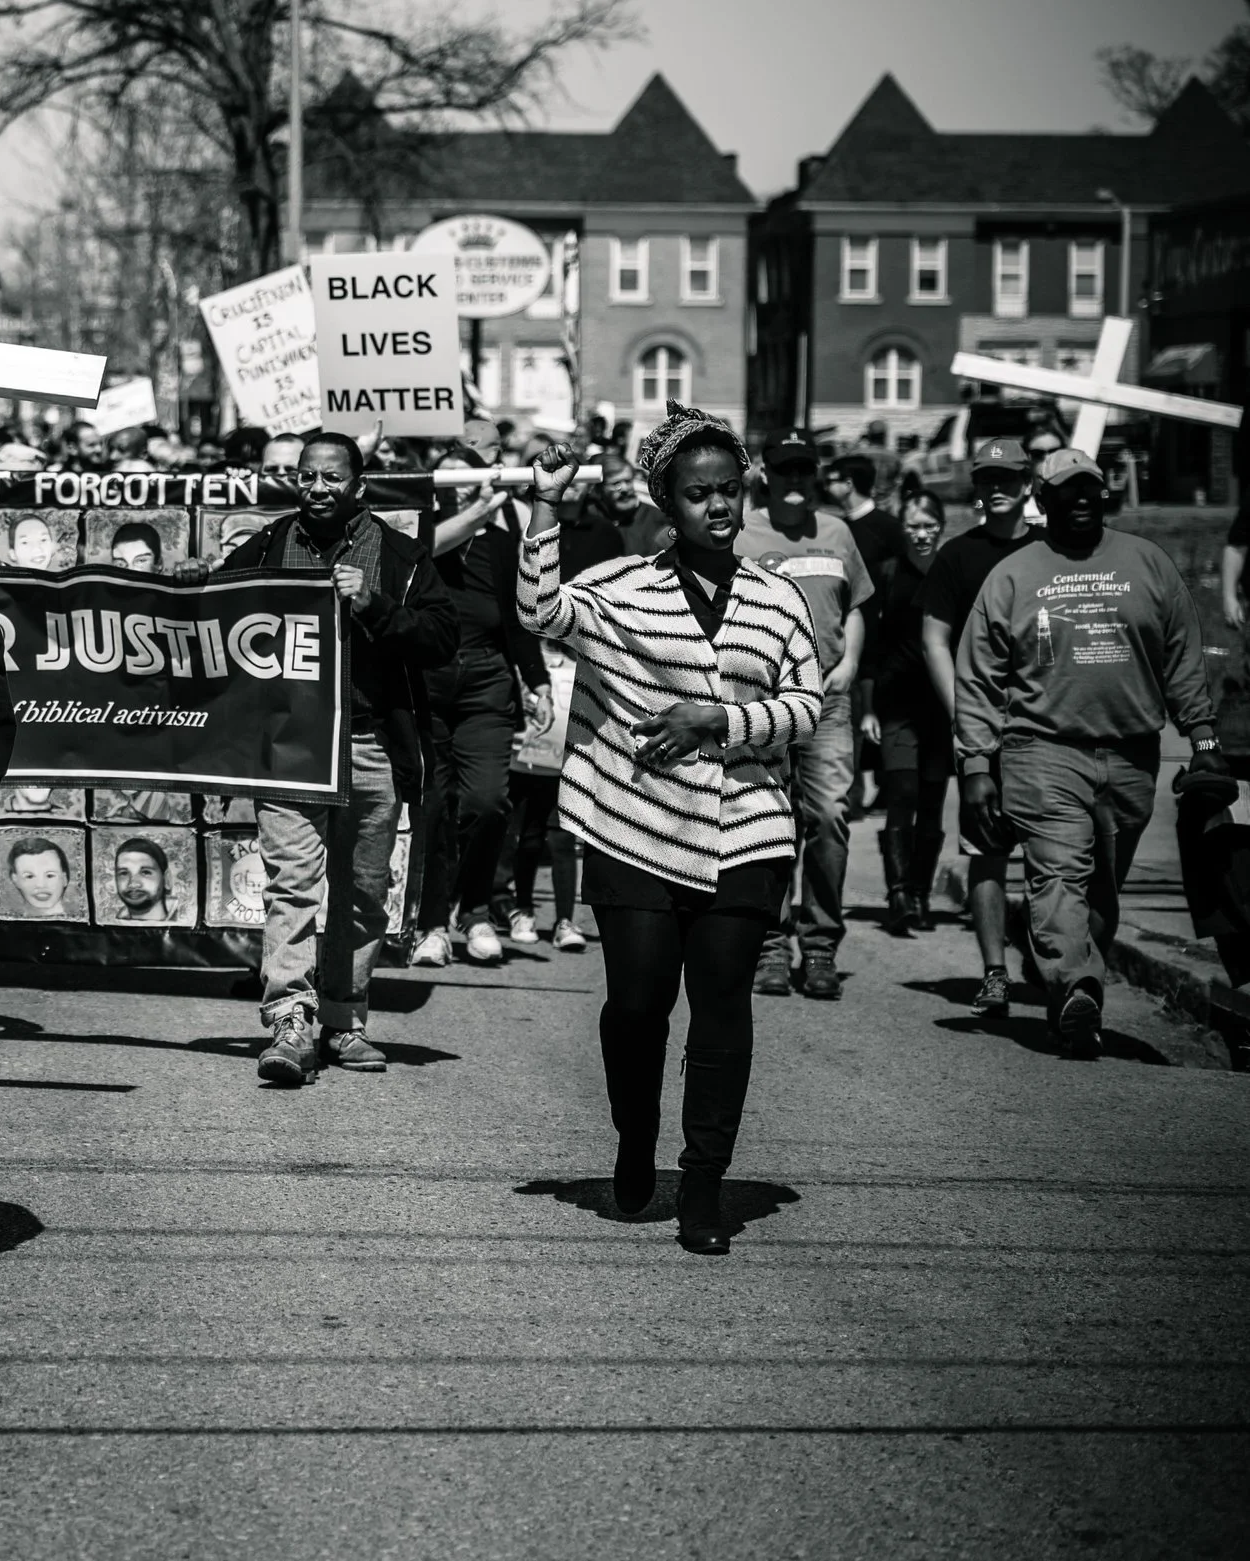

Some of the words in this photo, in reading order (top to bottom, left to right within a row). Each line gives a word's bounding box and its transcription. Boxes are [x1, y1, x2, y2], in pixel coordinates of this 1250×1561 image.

[328, 273, 438, 300] BLACK
[457, 292, 507, 302] ENTER
[252, 313, 273, 330] IS
[236, 325, 310, 364] CAPITAL
[341, 331, 433, 357] LIVES
[275, 375, 295, 392] IS
[262, 384, 316, 420] LETHAL
[327, 387, 454, 412] MATTER
[35, 472, 258, 506] FORGOTTEN
[1036, 584, 1088, 597] Christian
[1091, 581, 1131, 592] Church
[1052, 571, 1117, 584] Centennial
[36, 609, 320, 681] JUSTICE
[21, 700, 112, 723] biblical
[113, 704, 209, 728] activism
